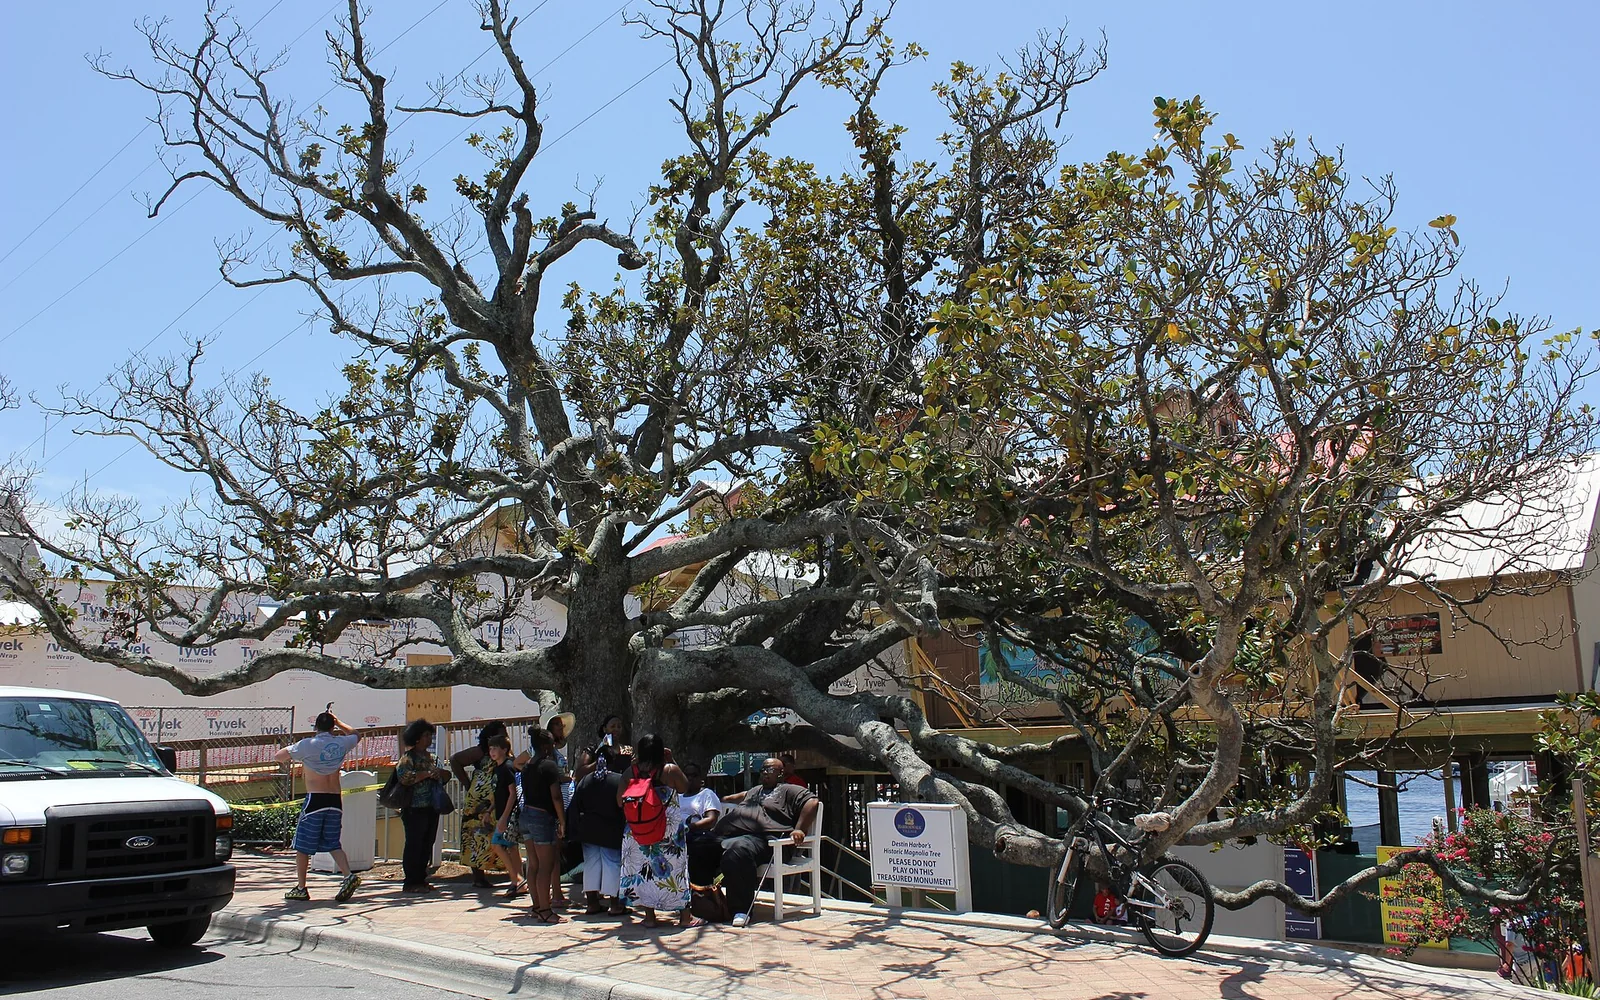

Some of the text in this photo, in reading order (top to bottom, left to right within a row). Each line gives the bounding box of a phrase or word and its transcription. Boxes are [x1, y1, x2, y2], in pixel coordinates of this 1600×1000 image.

[533, 626, 561, 639] Tyvek
[206, 717, 247, 732] Tyvek
[904, 849, 929, 857] Magnolia
[888, 858, 937, 868] PLEASE DO NOT
[892, 866, 934, 876] PLAY ON THIS
[877, 873, 952, 886] TREASURED MONUMENT
